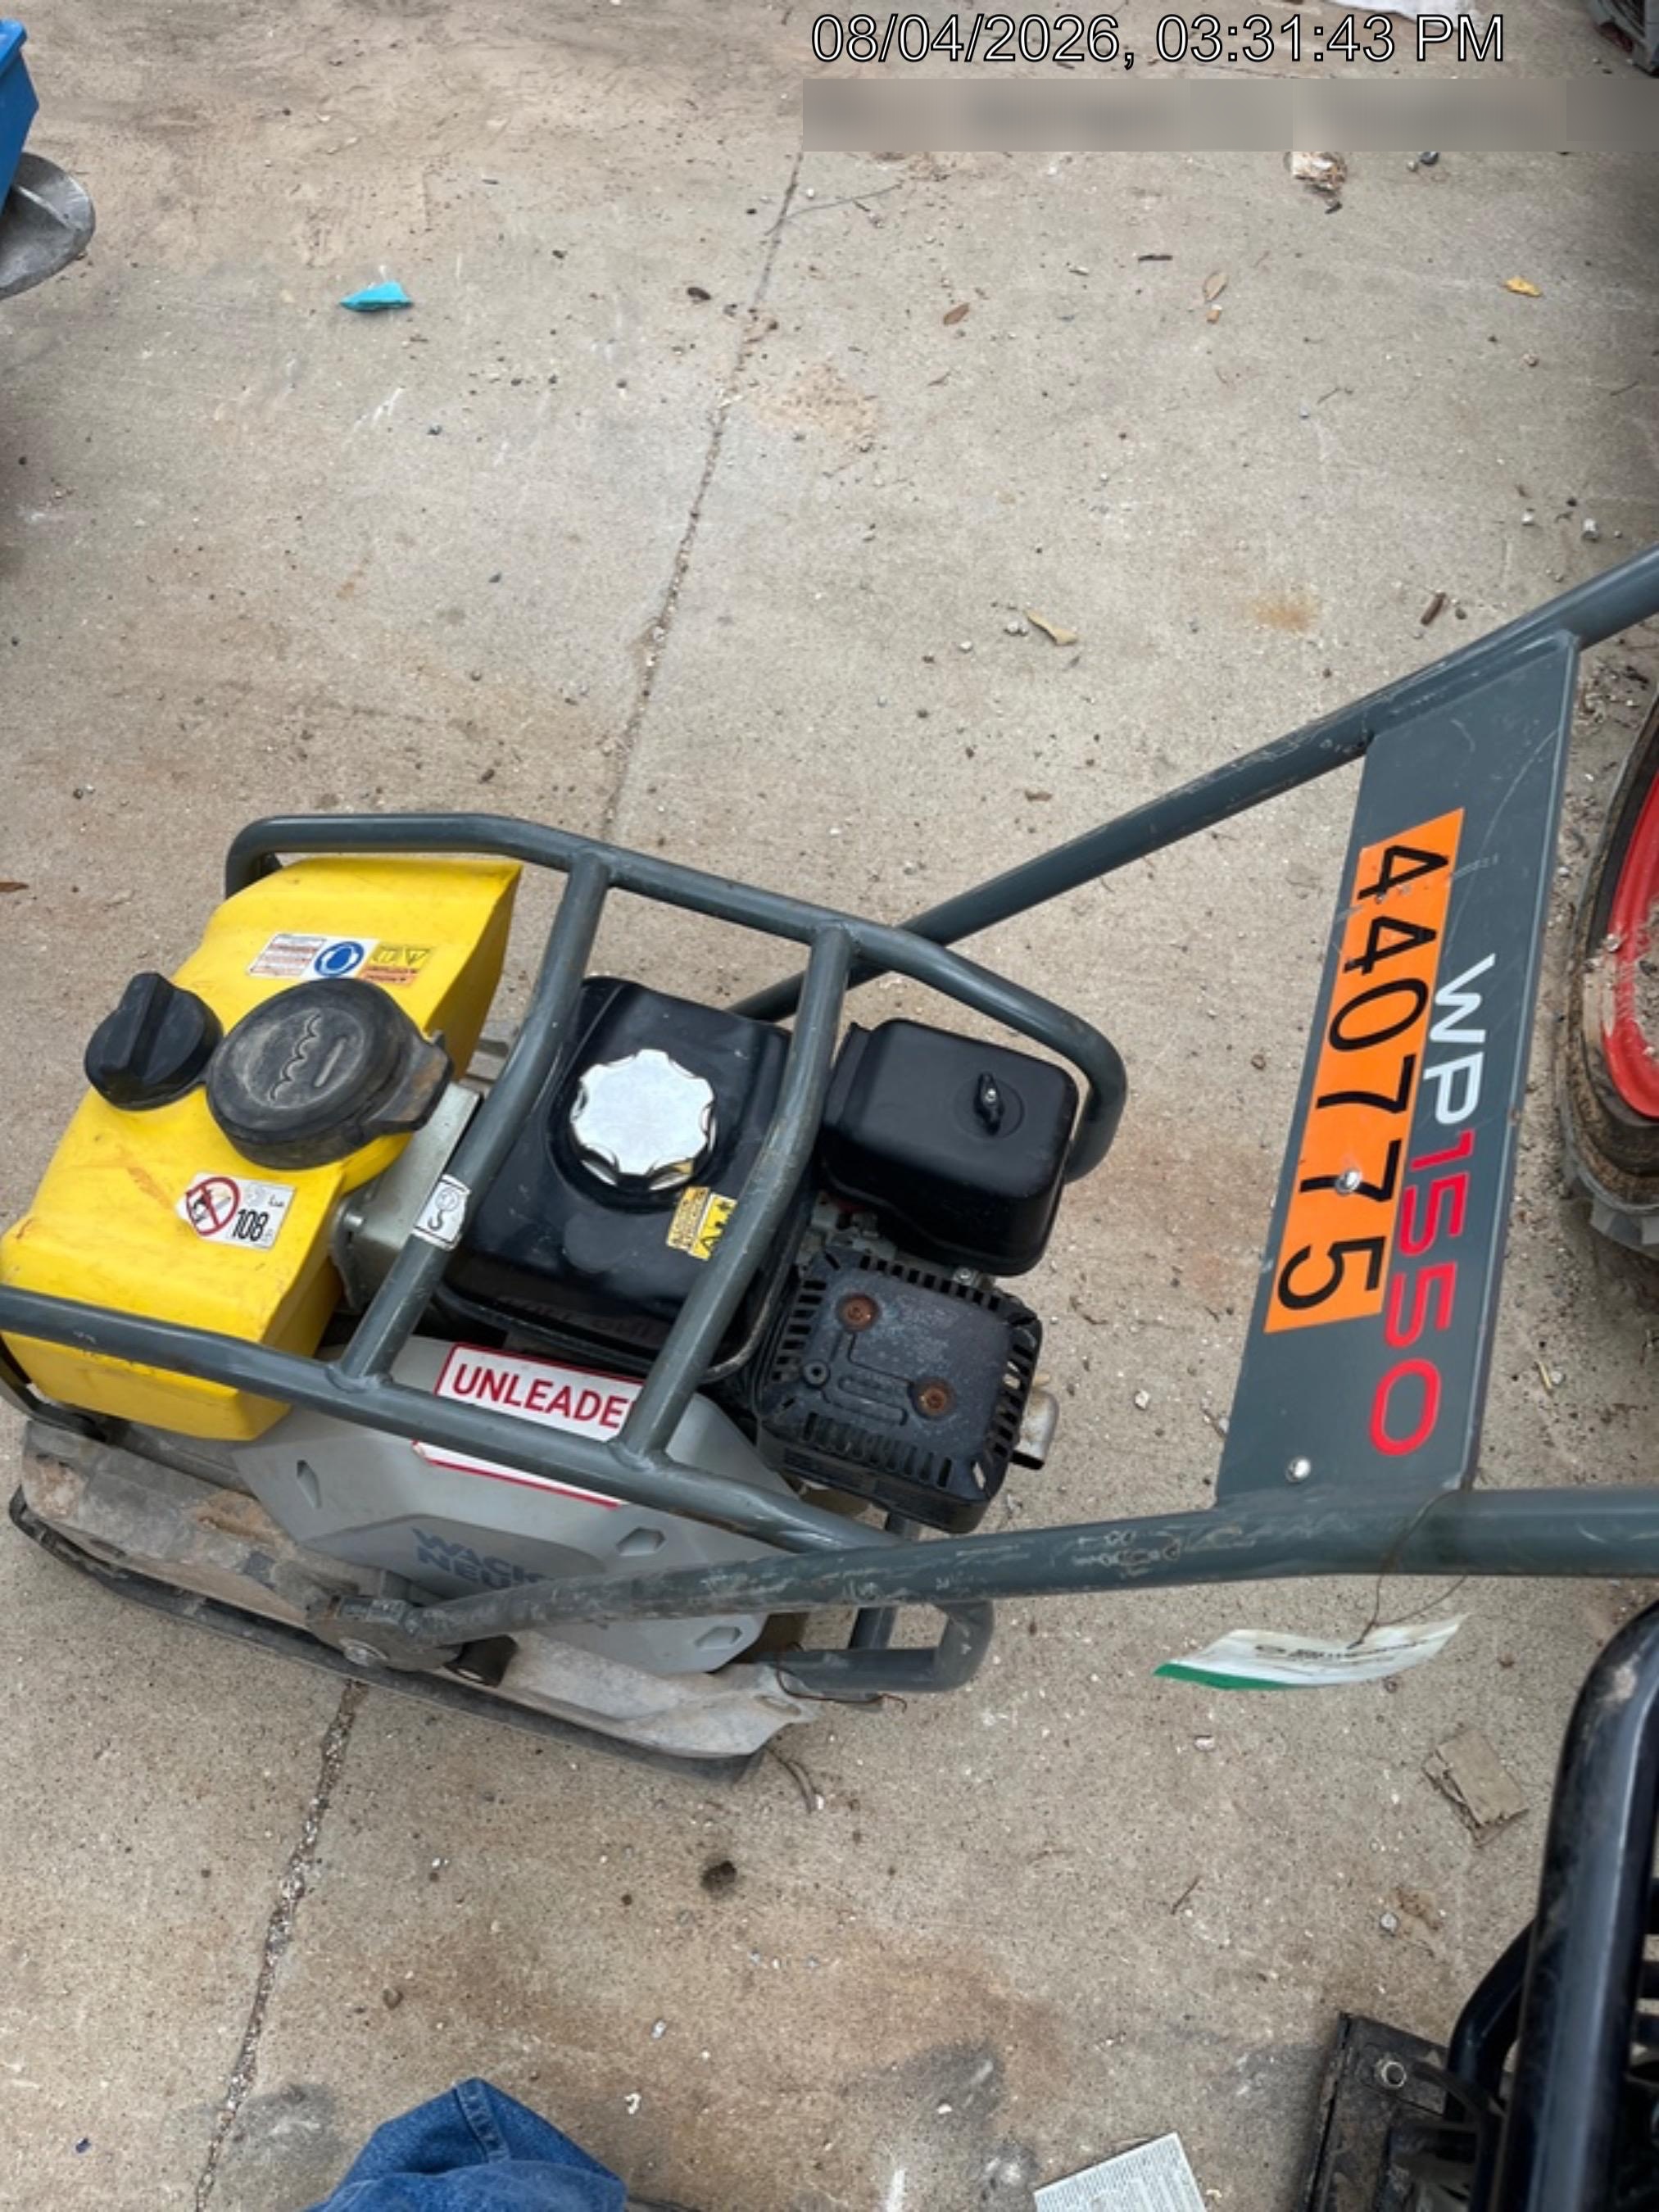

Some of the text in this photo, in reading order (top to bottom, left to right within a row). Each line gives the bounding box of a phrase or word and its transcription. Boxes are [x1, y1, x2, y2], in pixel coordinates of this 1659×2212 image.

[1277, 845, 1449, 1311] 440775
[1368, 953, 1496, 1457] WP1550
[232, 1207, 270, 1242] 108
[451, 1363, 633, 1429] UNLEADE
